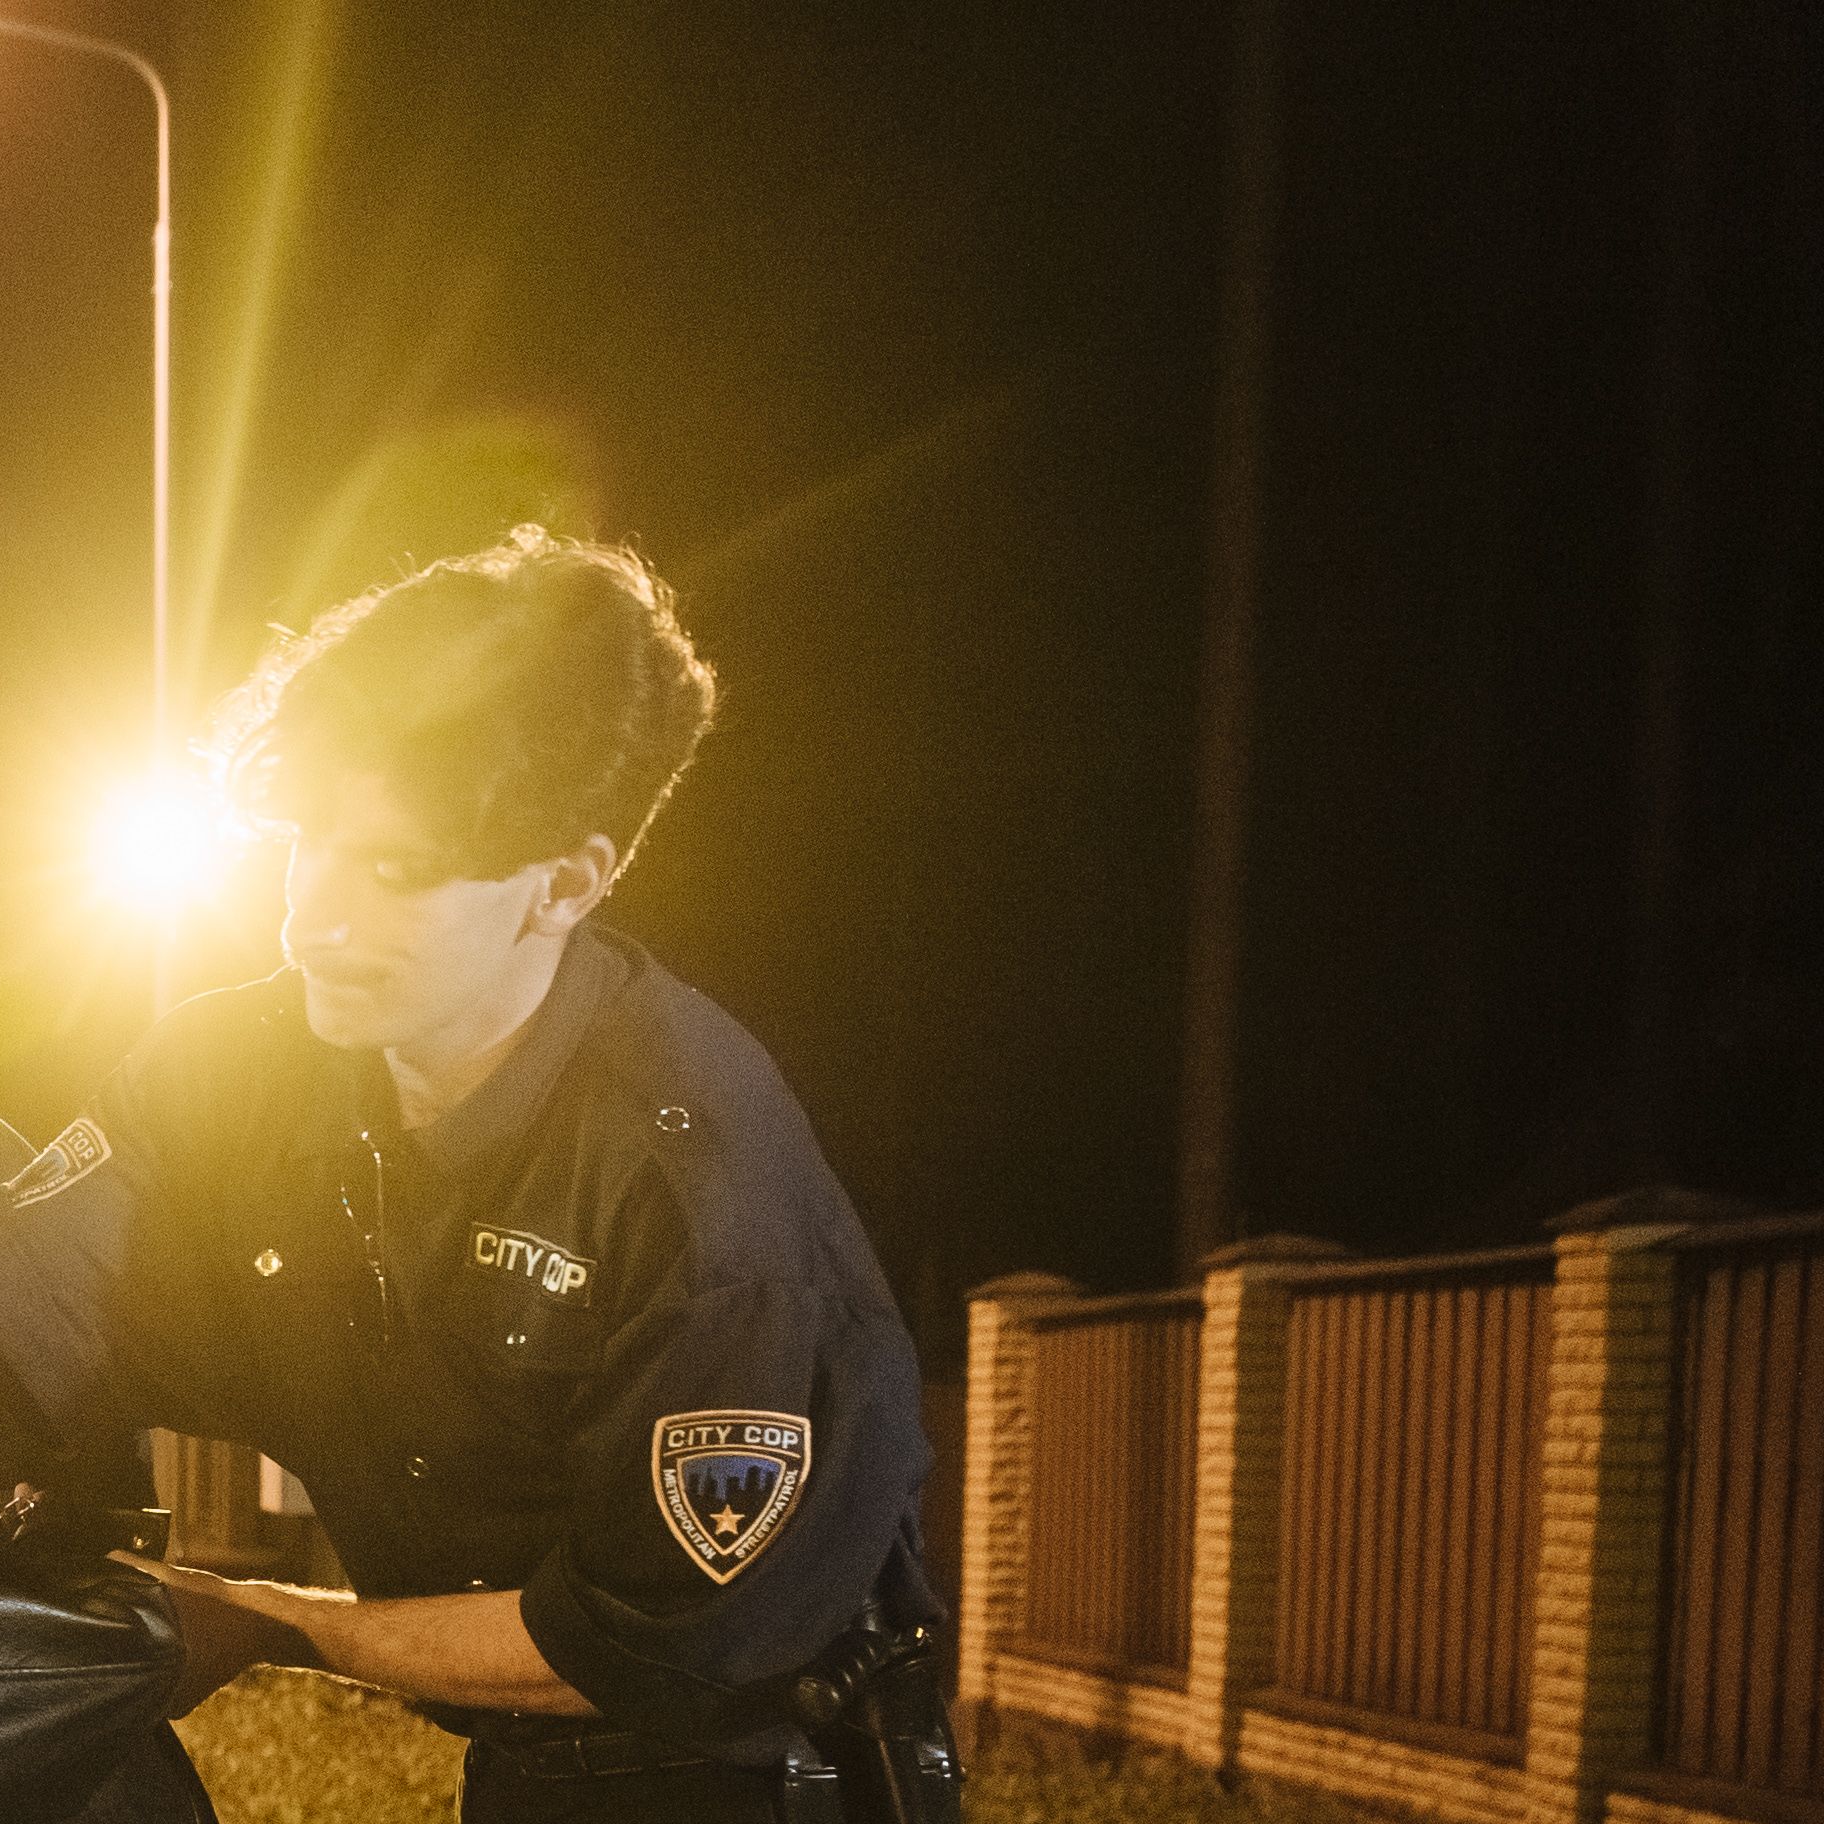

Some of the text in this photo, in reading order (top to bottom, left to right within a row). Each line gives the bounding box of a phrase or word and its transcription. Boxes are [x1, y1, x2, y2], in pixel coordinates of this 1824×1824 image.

[475, 1231, 544, 1277] CITY
[668, 1425, 799, 1449] CITY COP
[663, 1468, 716, 1560] METROPOLITAN
